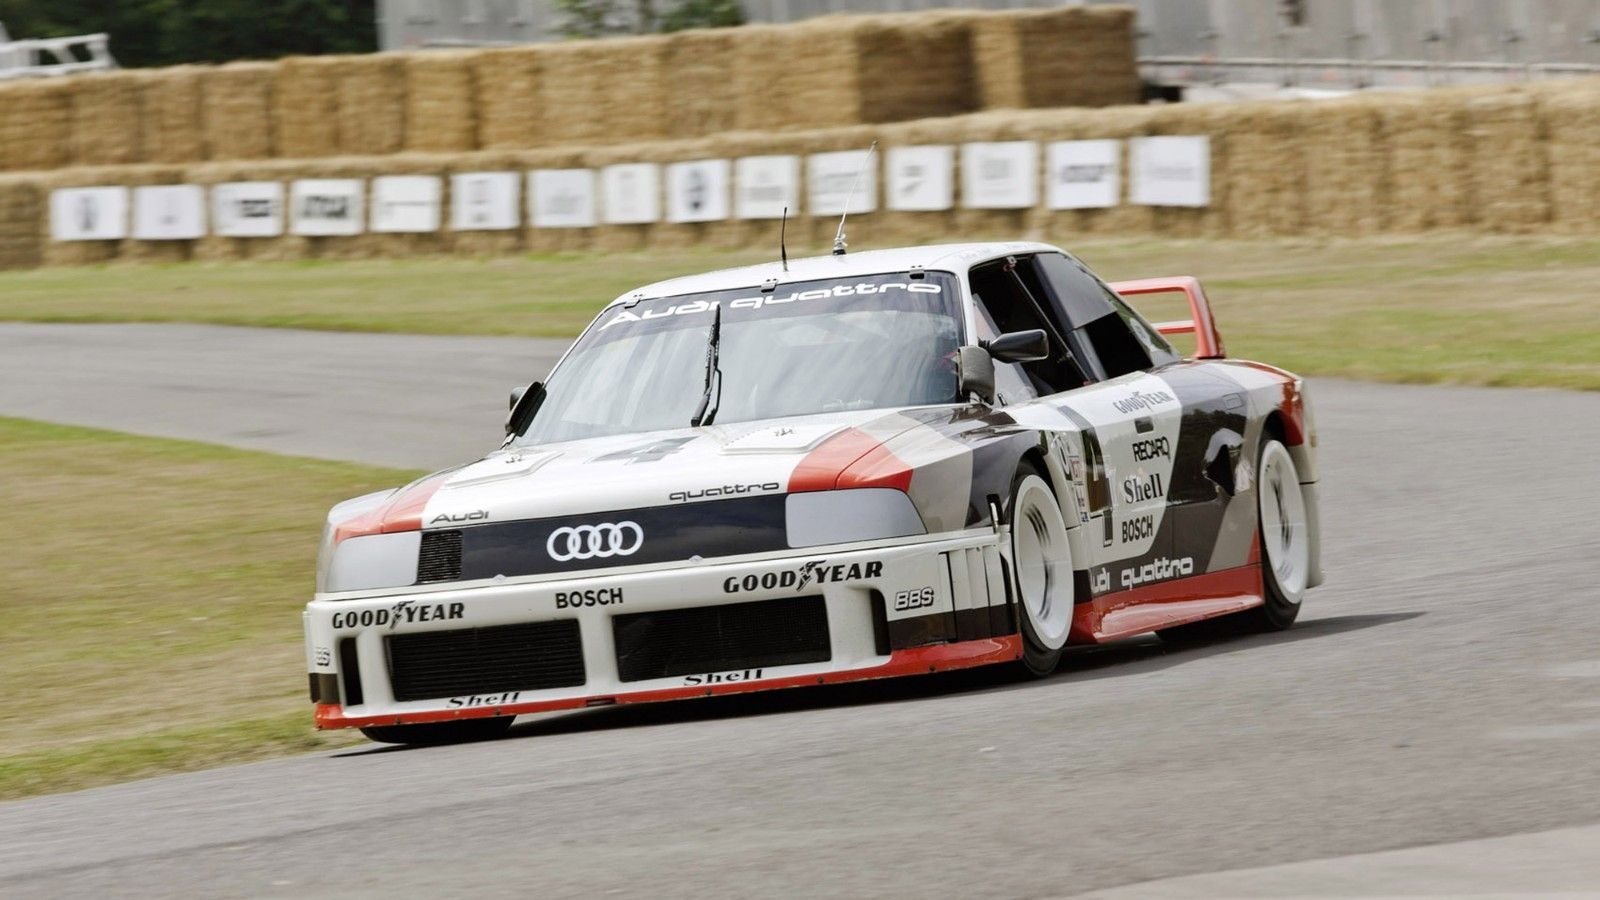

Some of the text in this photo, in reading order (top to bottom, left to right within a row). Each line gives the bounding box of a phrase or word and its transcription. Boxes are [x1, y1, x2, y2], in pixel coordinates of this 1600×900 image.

[597, 282, 942, 331] Audi quattro
[1132, 436, 1170, 461] RECARO
[669, 482, 780, 502] quattro
[1123, 473, 1163, 504] Shell
[430, 509, 490, 524] Audi
[1122, 515, 1153, 543] BOSCH
[1090, 556, 1193, 594] udi quattro
[555, 588, 623, 609] BOSCH
[894, 587, 934, 612] BBS
[683, 669, 762, 686] Shell
[446, 692, 521, 709] Shell
